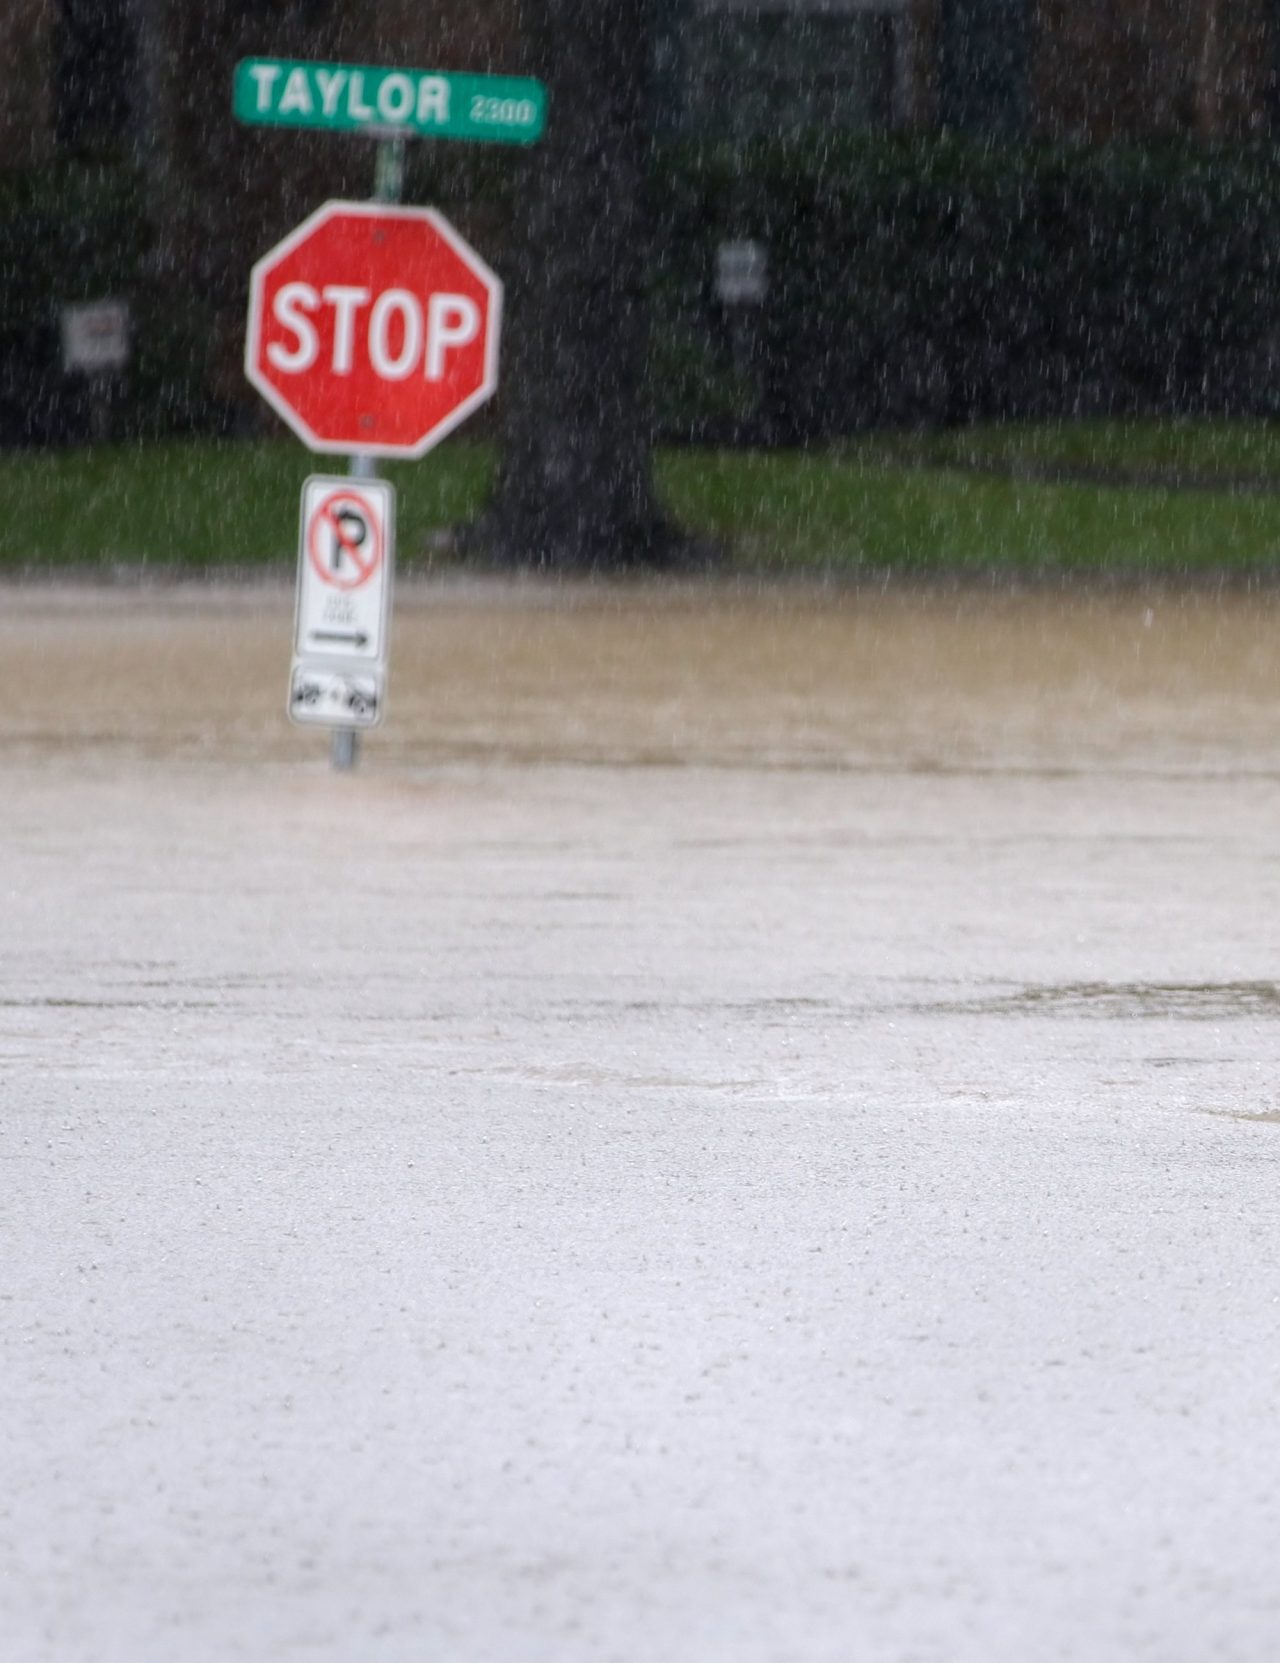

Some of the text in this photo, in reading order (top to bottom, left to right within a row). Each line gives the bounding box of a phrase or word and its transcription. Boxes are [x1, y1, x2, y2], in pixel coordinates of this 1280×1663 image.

[251, 63, 537, 126] TAYLOR 2300
[266, 281, 481, 382] STOP
[331, 507, 367, 569] P
